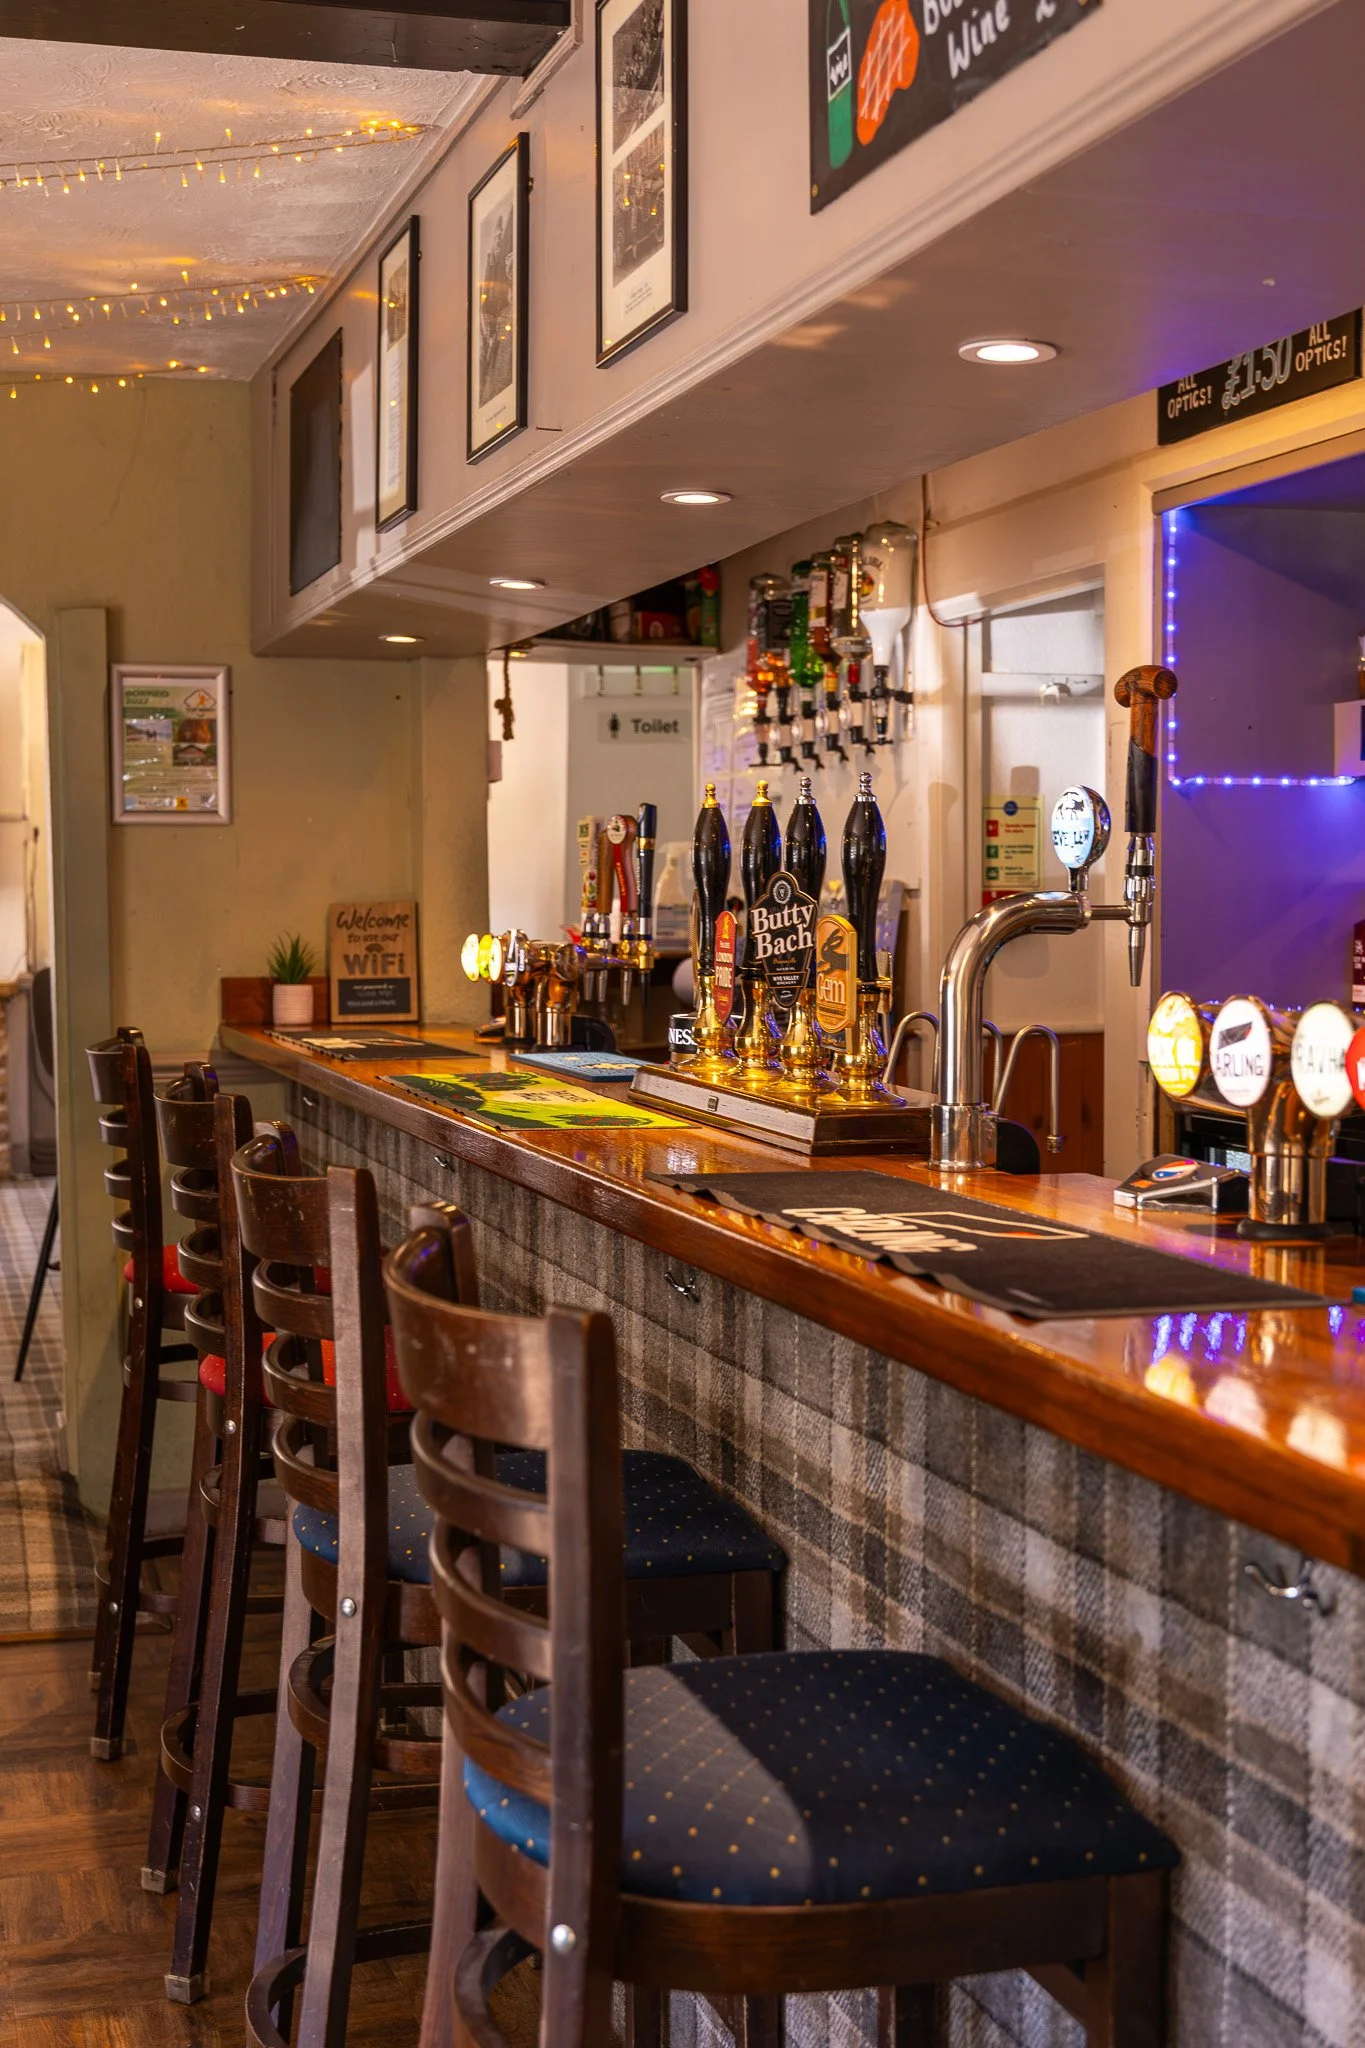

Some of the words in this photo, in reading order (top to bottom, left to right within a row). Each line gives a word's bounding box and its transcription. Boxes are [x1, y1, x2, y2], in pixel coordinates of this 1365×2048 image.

[946, 0, 1011, 80] Wine
[1309, 320, 1331, 346] ALL
[1295, 335, 1348, 373] OPTICS!
[1177, 373, 1198, 394] ALL
[1221, 334, 1293, 410] £1.50
[1167, 385, 1213, 419] OPTICS!
[630, 718, 679, 734] Toilet
[336, 907, 410, 932] Welcome
[751, 904, 815, 936] Butty
[755, 925, 815, 960] Bach
[343, 953, 405, 975] WiFi
[715, 965, 733, 988] PRIDE
[817, 972, 846, 1004] Gem
[1214, 1053, 1265, 1078] ARLING
